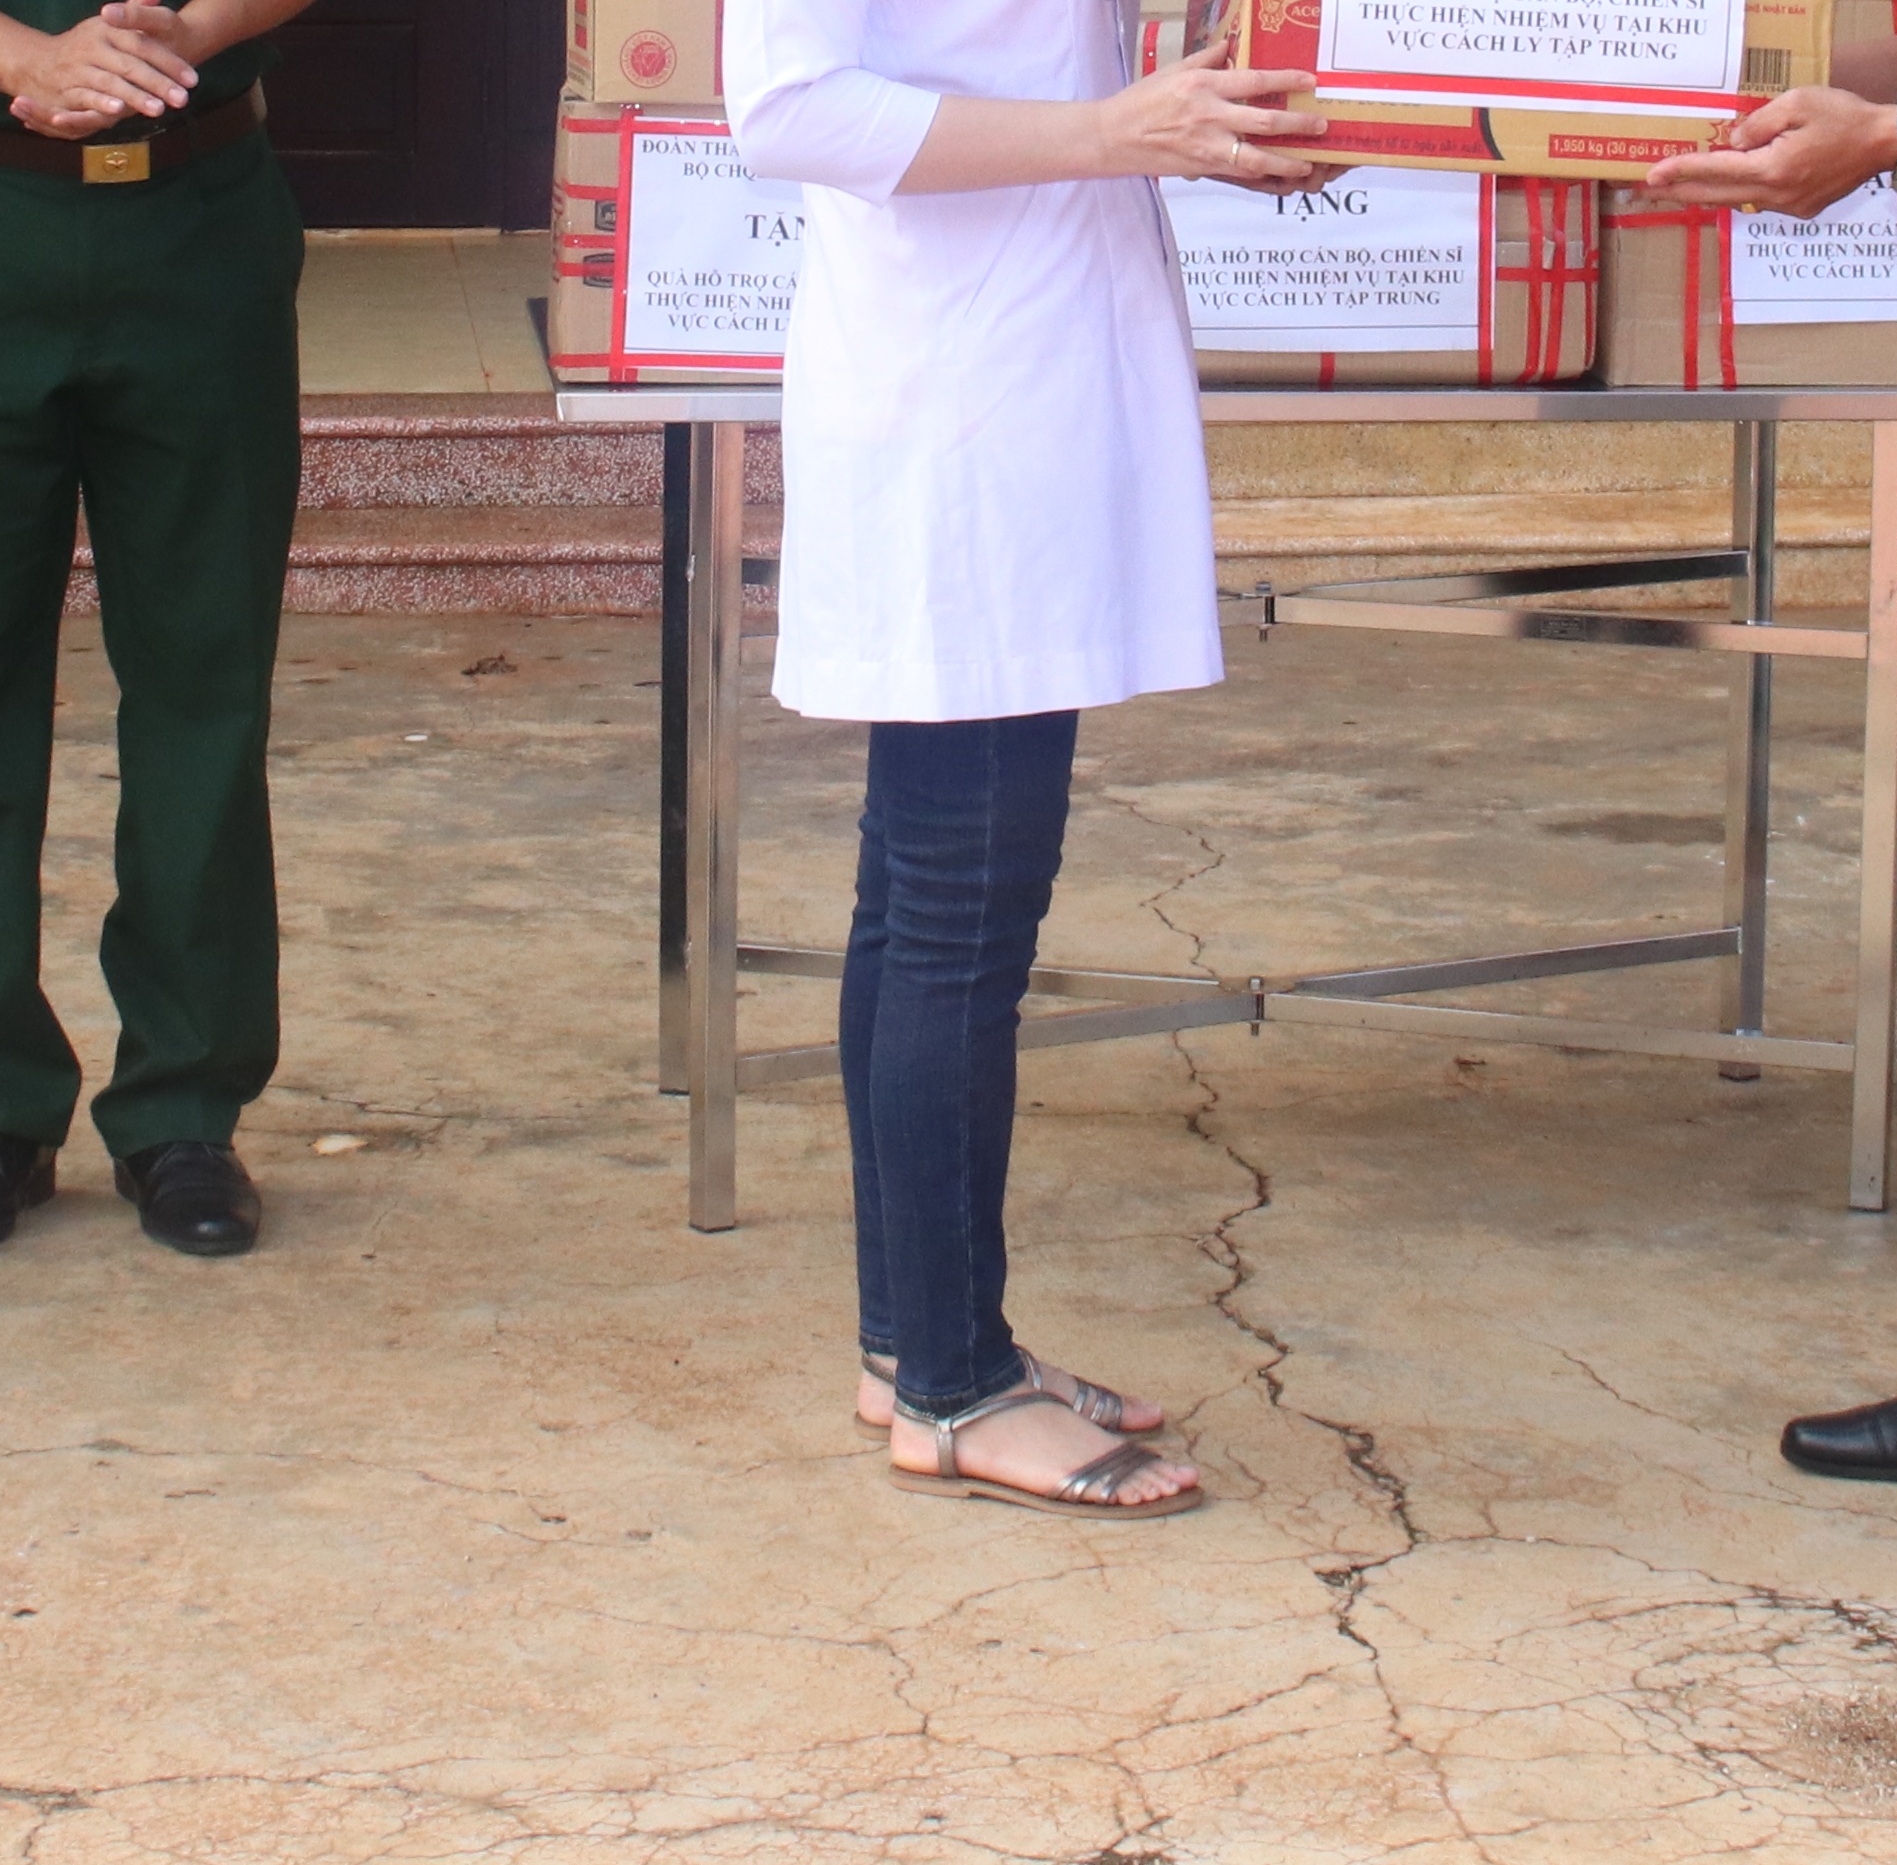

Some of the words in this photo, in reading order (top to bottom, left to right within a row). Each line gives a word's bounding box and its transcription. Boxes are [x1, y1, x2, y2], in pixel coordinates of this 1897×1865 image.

[1359, 3, 1425, 28] THỰC
[1431, 4, 1487, 28] HIỆN
[1492, 8, 1569, 32] NHIỆM
[1577, 13, 1606, 34] VỤ
[1613, 15, 1652, 37] TẠI
[1659, 17, 1708, 36] KHU
[1386, 30, 1436, 51] VỰC
[1441, 28, 1505, 52] CÁCH
[1512, 36, 1543, 53] LY
[1549, 35, 1593, 59] TẬP
[1599, 40, 1678, 61] TRUNG
[641, 136, 696, 154] ĐOÀN
[702, 140, 740, 157] THA
[1553, 138, 1585, 153] 1,950
[1588, 140, 1604, 157] kg
[1606, 141, 1626, 156] (30
[1629, 141, 1649, 158] gói
[1651, 146, 1660, 156] x
[1662, 144, 1677, 157] 65
[683, 162, 709, 180] BỘ
[714, 163, 756, 181] CHQ
[1748, 219, 1787, 239] QUÀ
[1792, 219, 1820, 238] HỖ
[1824, 222, 1864, 241] TRỢ
[1177, 246, 1215, 267] QUÀ
[1221, 246, 1250, 265] HỖ
[1254, 248, 1296, 267] TRỢ
[1300, 246, 1339, 265] CÁN
[1344, 247, 1377, 266] BỘ,
[1380, 244, 1441, 265] CHIẾN
[1445, 246, 1463, 264] SĨ
[1746, 243, 1798, 261] THỰC
[1803, 242, 1848, 261] HIỆN
[647, 268, 689, 288] QUÀ
[694, 269, 722, 287] HỖ
[727, 273, 769, 292] TRỢ
[772, 270, 798, 290] CÁ
[1233, 269, 1279, 289] HIỆN
[1284, 268, 1350, 288] NHIỆM
[1355, 270, 1381, 289] VỤ
[1385, 269, 1419, 288] TẠI
[1423, 268, 1465, 285] KHU
[1768, 264, 1808, 282] VỰC
[1812, 261, 1864, 279] CÁCH
[1870, 264, 1892, 279] LY
[644, 292, 700, 312] THỰC
[704, 293, 751, 312] HIỆN
[757, 296, 792, 311] NHI
[1198, 291, 1239, 311] VỰC
[1243, 288, 1297, 307] CÁCH
[1302, 291, 1330, 306] LY
[1334, 288, 1369, 309] TẬP
[1373, 291, 1441, 306] TRUNG
[667, 314, 709, 332] VỰC
[714, 312, 768, 332] CÁCH
